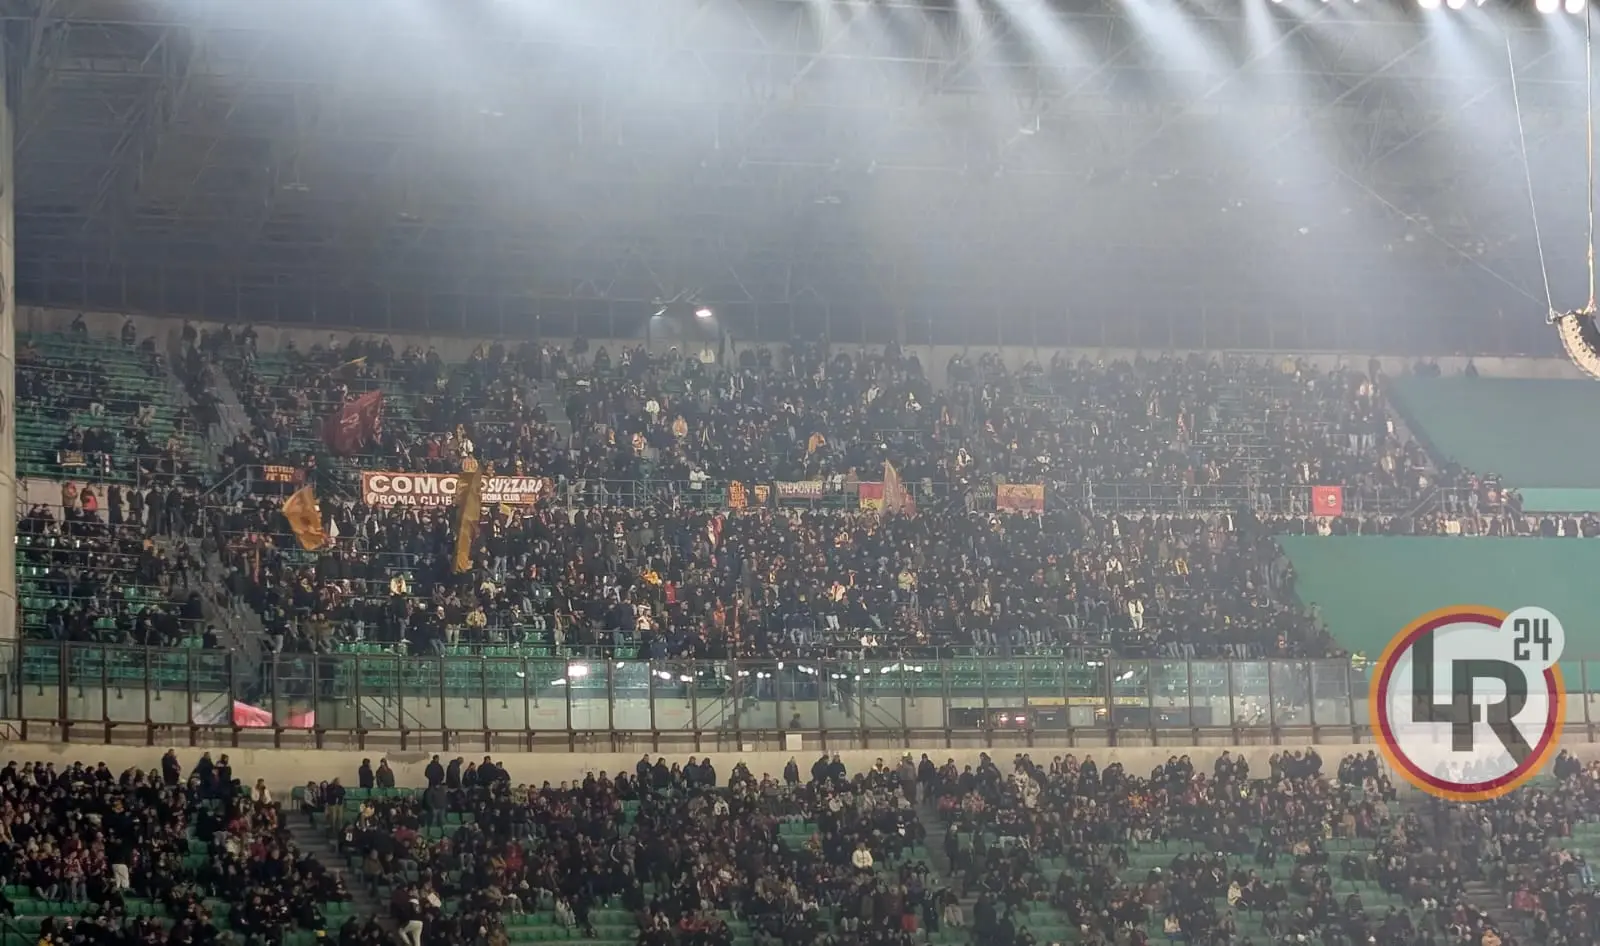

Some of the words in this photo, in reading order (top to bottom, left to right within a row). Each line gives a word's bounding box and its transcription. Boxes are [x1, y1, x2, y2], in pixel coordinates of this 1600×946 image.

[369, 475, 458, 494] COMO
[379, 495, 417, 505] ROMA
[420, 495, 452, 505] CLUB
[482, 493, 501, 501] ROMA
